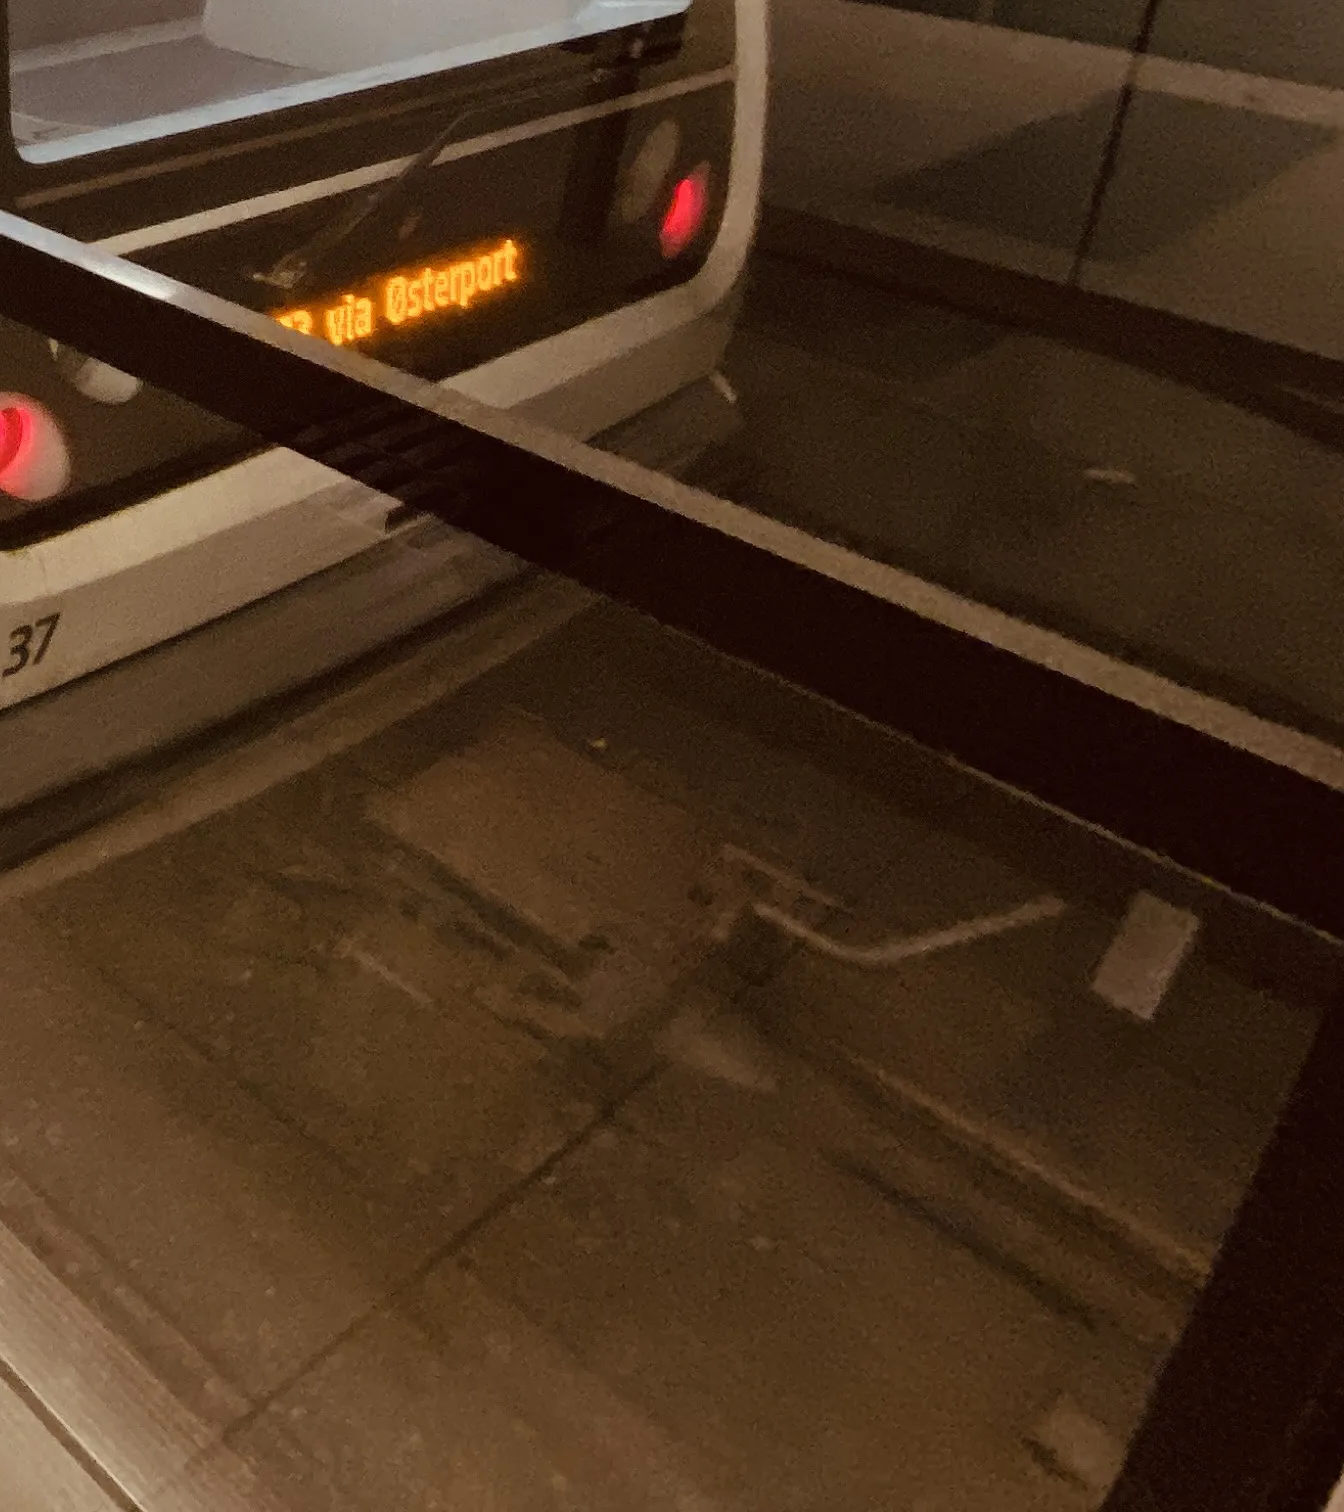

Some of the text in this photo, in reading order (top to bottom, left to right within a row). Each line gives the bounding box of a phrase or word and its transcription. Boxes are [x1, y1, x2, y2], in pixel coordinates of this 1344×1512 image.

[325, 293, 373, 346] via
[385, 239, 517, 325] Østerport
[2, 612, 60, 678] 37
